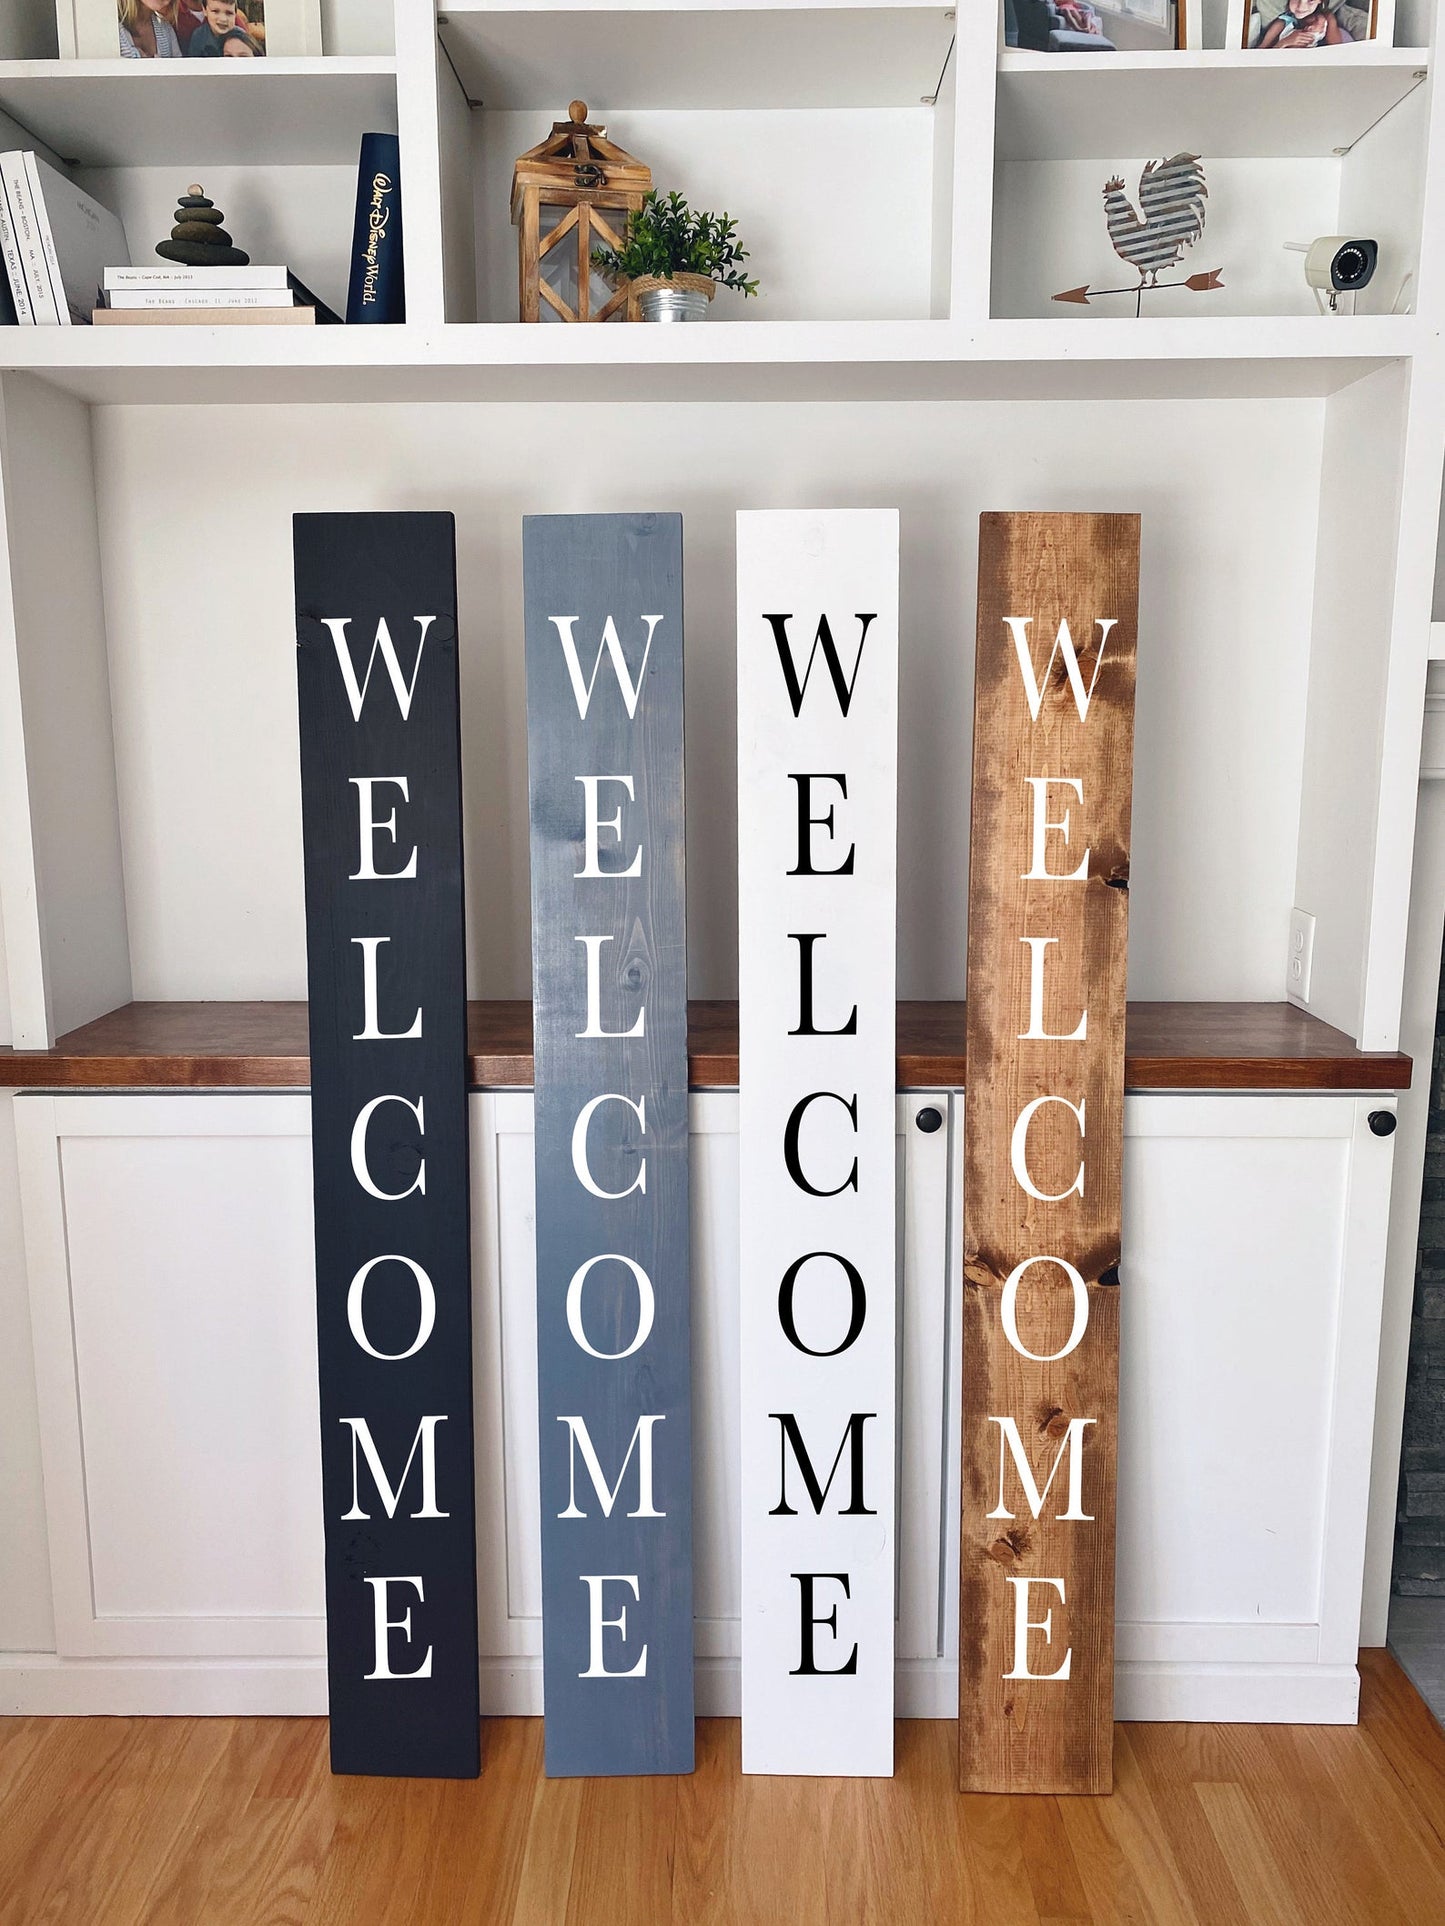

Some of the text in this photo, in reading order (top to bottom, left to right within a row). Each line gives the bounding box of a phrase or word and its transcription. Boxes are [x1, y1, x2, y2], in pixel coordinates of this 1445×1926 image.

[7, 249, 17, 271] TEXAS
[18, 298, 27, 315] 2014
[320, 615, 450, 1680] WELCOME
[548, 614, 667, 1678] WELCOME
[762, 613, 877, 1675] WELCOME
[986, 616, 1118, 1680] WELCOME
